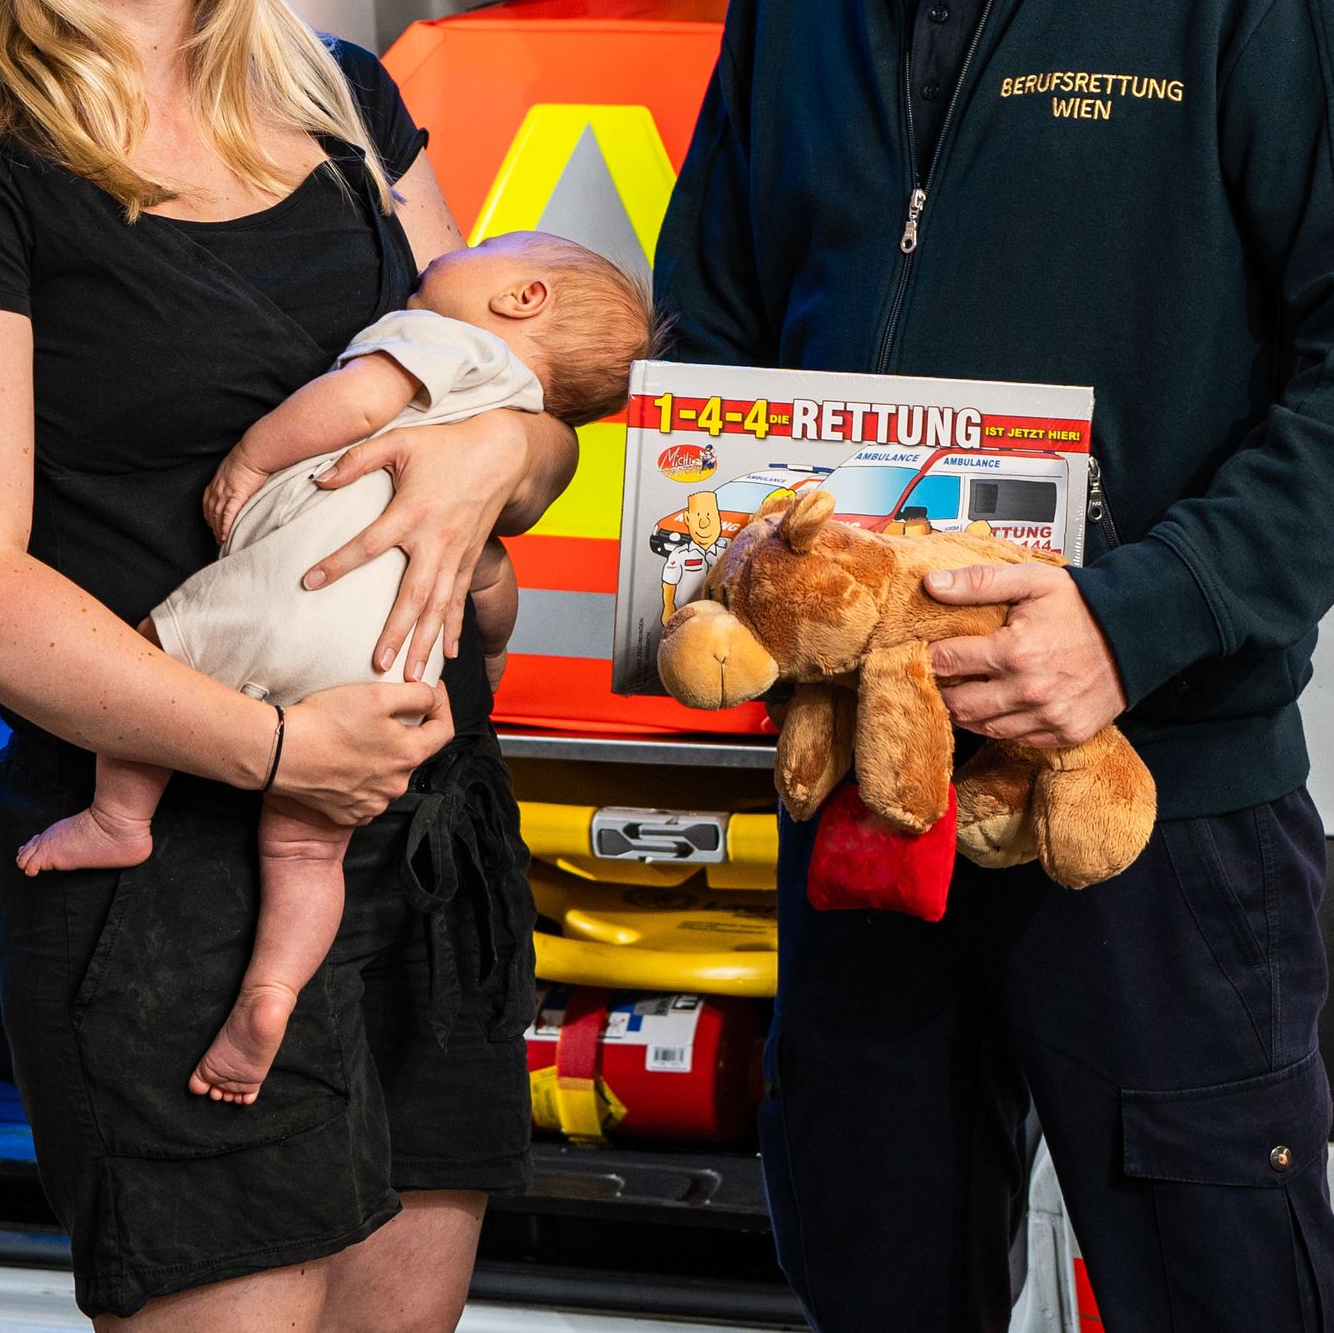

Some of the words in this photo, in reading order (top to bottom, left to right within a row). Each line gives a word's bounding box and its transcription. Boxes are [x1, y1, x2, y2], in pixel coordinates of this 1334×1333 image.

[1000, 71, 1185, 102] BERUFSRETTUNG
[1052, 97, 1113, 120] WIEN
[654, 393, 769, 439] 1-4-4
[770, 415, 790, 424] DIE
[791, 398, 982, 449] RETTUNG
[985, 426, 1005, 436] IST
[1007, 428, 1045, 439] JETZT
[1048, 430, 1080, 441] HIER!
[855, 452, 920, 463] AMBULANCE
[943, 457, 1001, 468] AMBULANCE
[992, 526, 1052, 538] TTUNG
